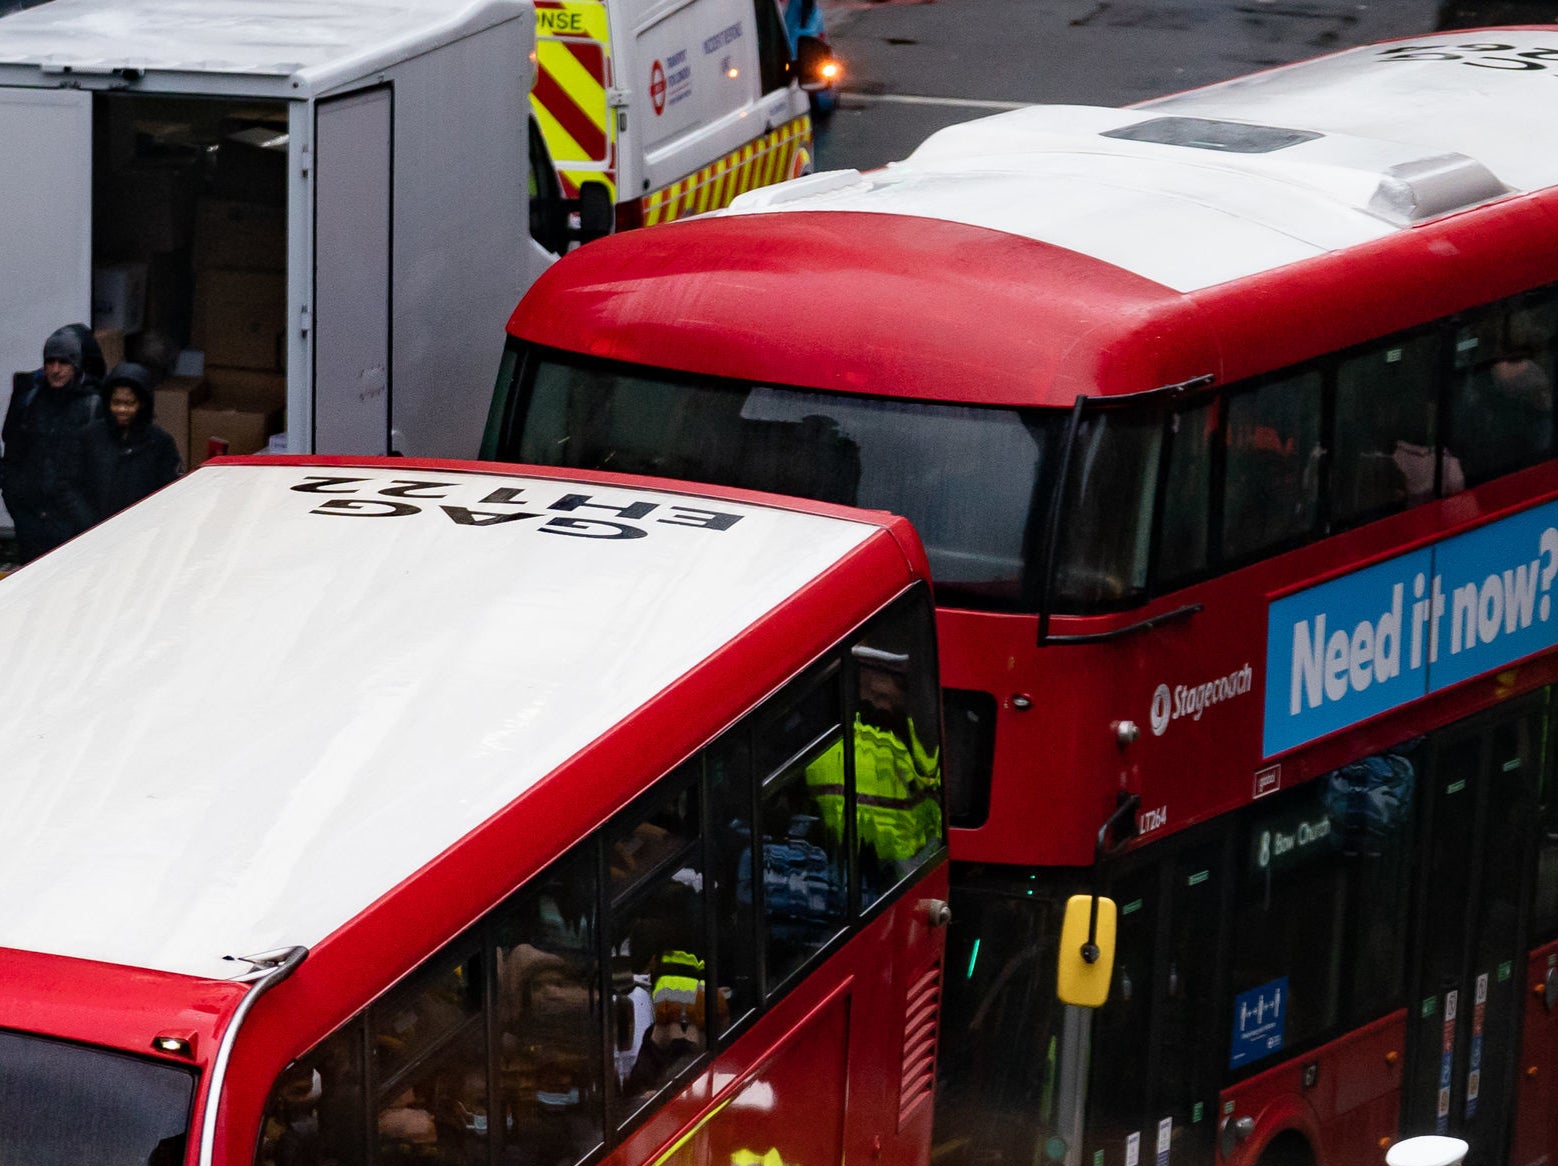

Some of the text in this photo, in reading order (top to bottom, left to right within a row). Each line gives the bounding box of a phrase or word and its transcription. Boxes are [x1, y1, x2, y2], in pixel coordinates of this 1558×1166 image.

[289, 475, 746, 532] EH122
[308, 498, 649, 540] GAG
[1290, 582, 1405, 716] Need
[1409, 572, 1446, 671] it
[1171, 662, 1253, 721] Stagecoach
